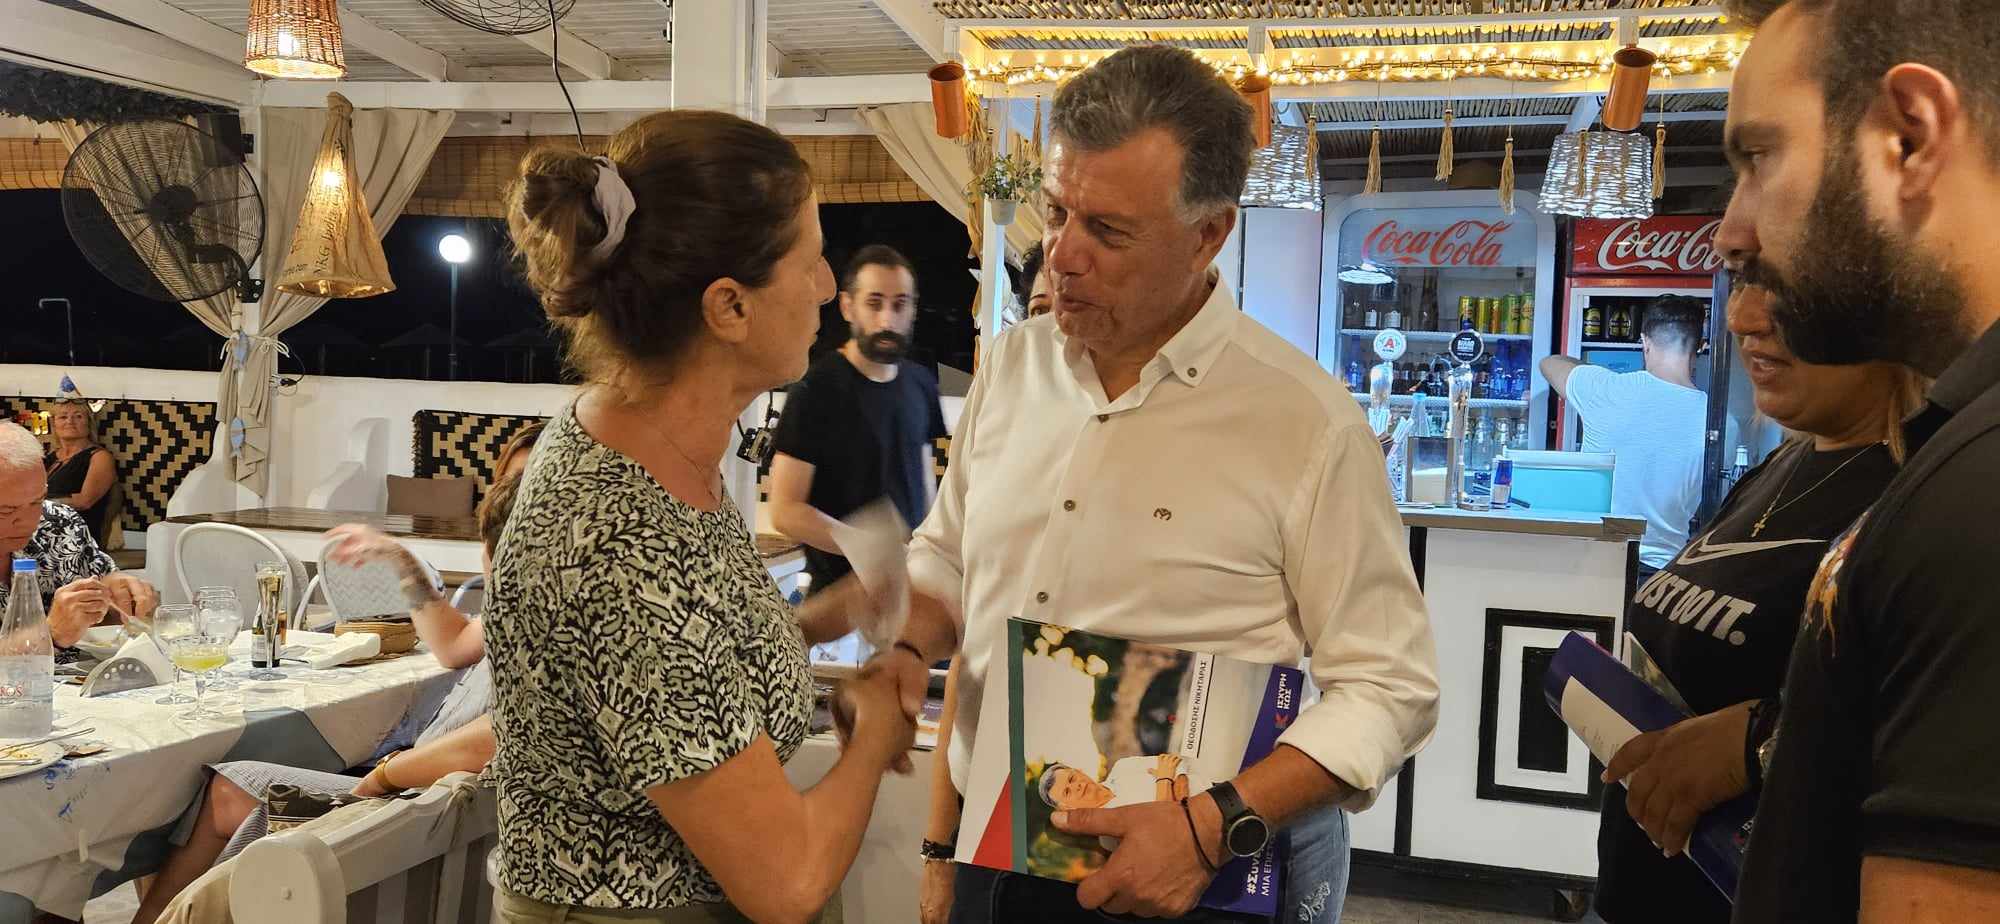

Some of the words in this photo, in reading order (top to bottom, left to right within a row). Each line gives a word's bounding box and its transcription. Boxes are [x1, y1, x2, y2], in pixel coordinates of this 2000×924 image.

[1361, 219, 1514, 266] Coca-Cola
[1597, 219, 1724, 271] Coca-Co
[1634, 569, 1691, 616] UST
[1668, 584, 1716, 625] DO
[1693, 594, 1757, 646] IT.
[0, 686, 23, 698] ROS
[1187, 705, 1200, 750] ΘΕΟΔΟΣΗΣ
[1194, 660, 1207, 705] ΝΙΚΗΤΑΡΑΣ
[1276, 672, 1287, 709] ΙΣΧΥΡΗ
[1283, 689, 1292, 710] ΚΩΣ
[1261, 874, 1272, 896] ΜΙΑ
